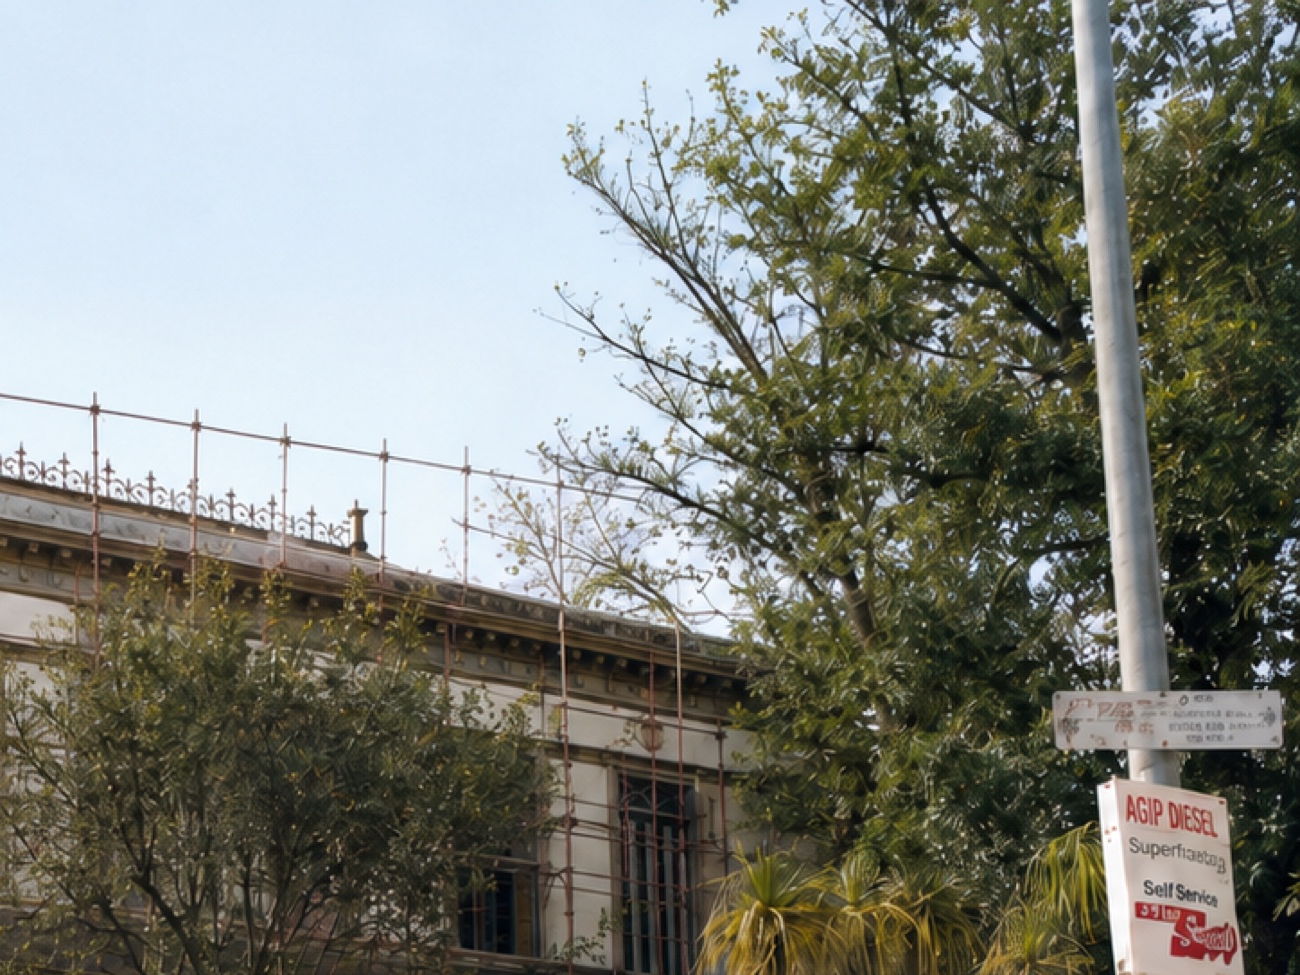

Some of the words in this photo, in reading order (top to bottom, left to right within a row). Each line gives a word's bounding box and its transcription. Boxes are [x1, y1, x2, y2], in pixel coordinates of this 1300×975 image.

[1126, 795, 1163, 825] AGIP
[1169, 802, 1218, 838] DIESEL
[1143, 880, 1173, 898] Self
[1176, 883, 1218, 908] Service
